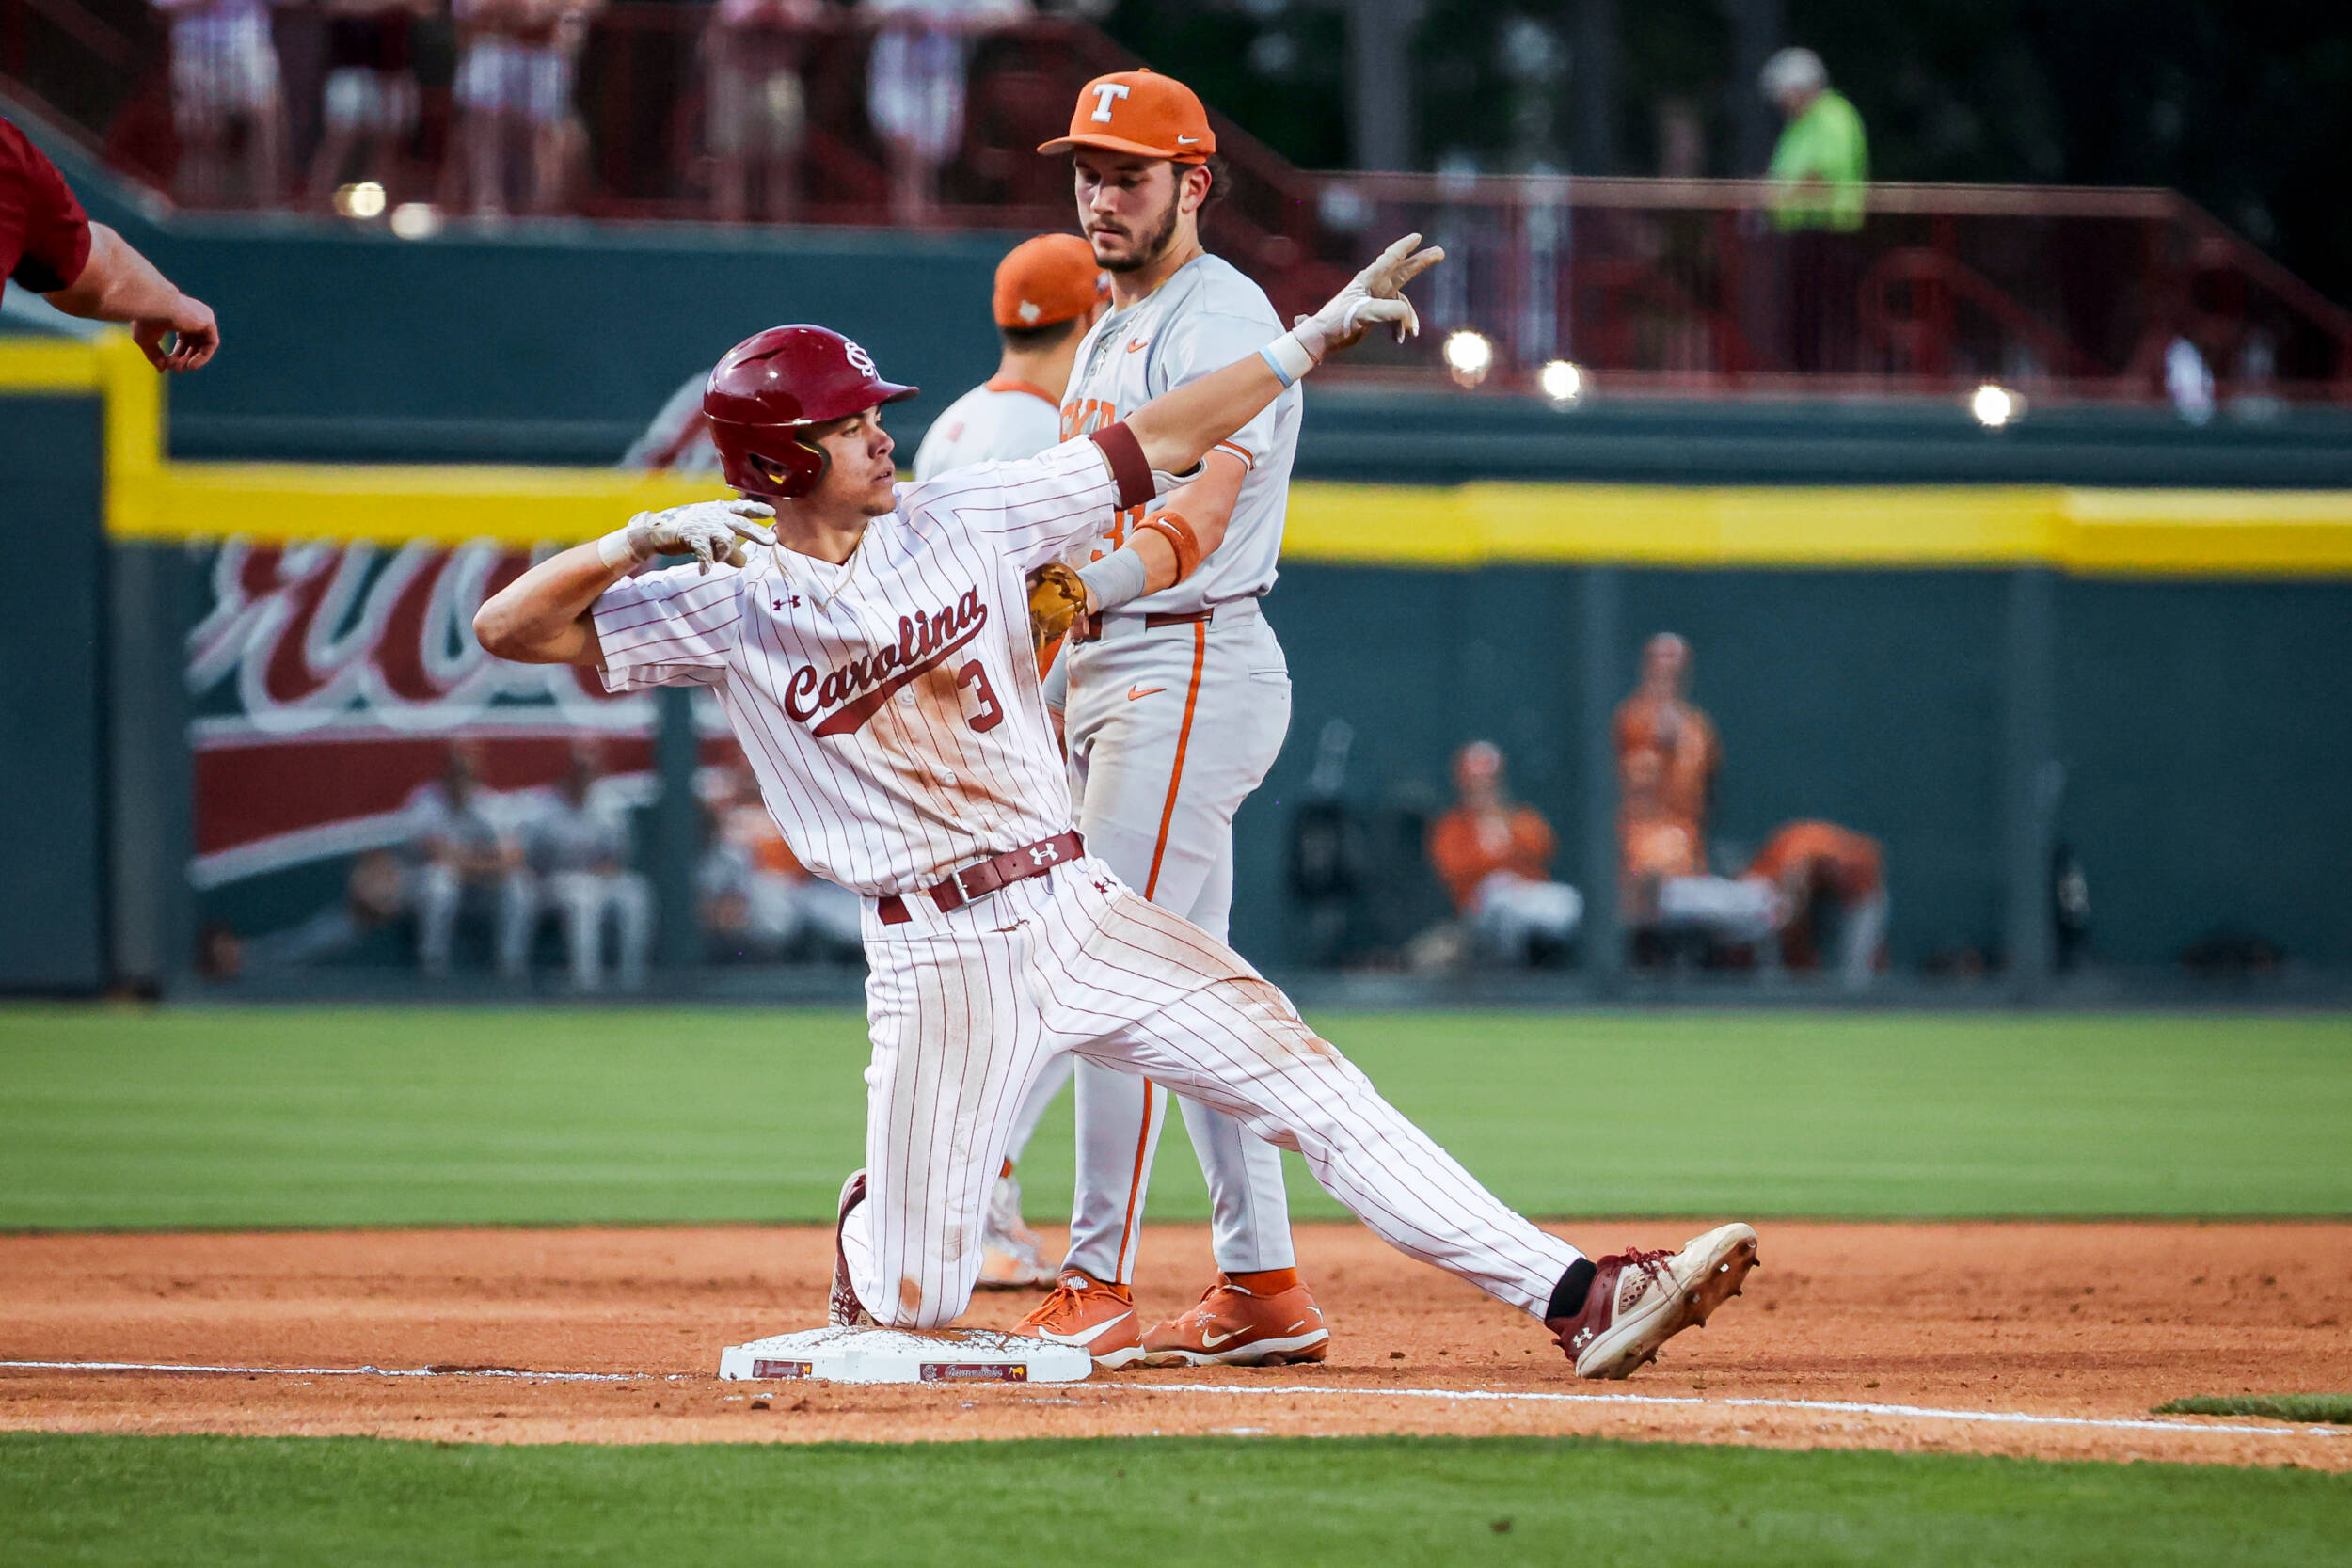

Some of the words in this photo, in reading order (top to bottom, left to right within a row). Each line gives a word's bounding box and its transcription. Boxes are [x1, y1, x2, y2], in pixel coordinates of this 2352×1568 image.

[1091, 83, 1130, 123] T
[784, 584, 989, 724] Carolina
[957, 658, 1004, 734] 3
